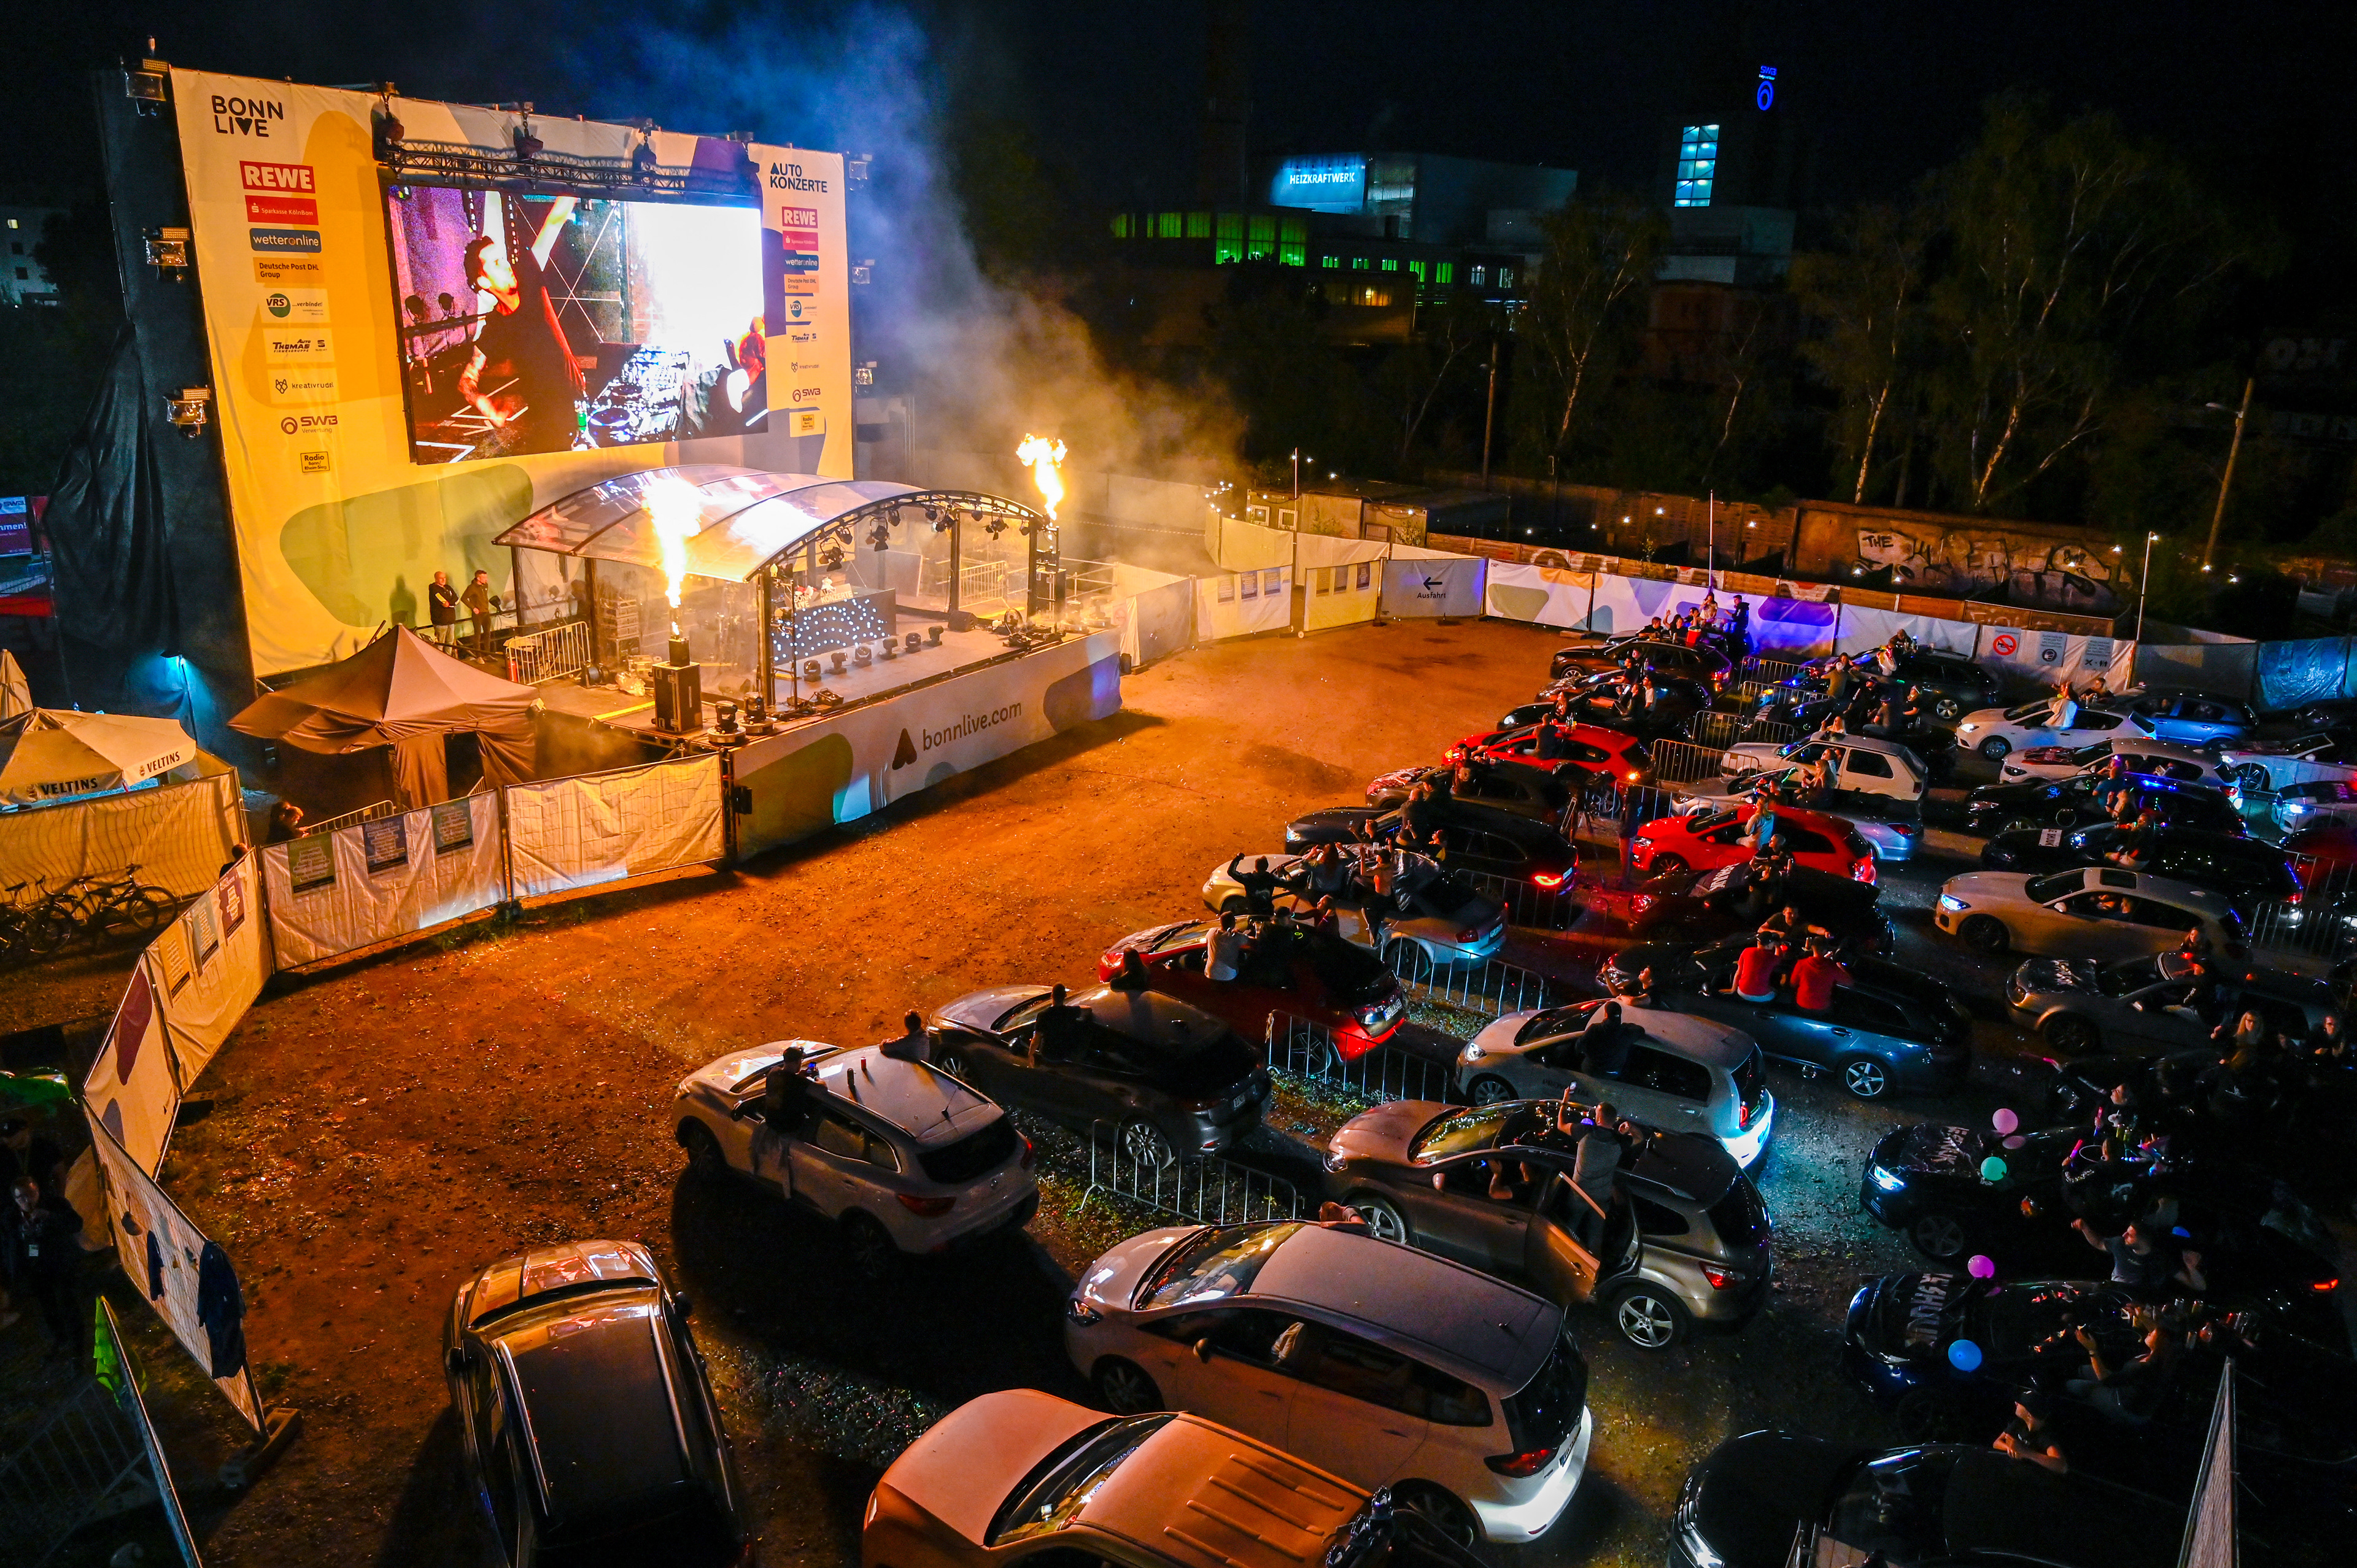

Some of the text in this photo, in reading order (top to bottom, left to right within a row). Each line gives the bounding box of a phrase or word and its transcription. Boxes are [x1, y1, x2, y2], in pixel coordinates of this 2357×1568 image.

[1760, 65, 1777, 75] SWB
[212, 95, 284, 120] BONN
[214, 115, 269, 137] LIVE
[244, 165, 312, 189] REWE
[770, 163, 802, 177] AUTO
[770, 176, 828, 193] KONZERTE
[1290, 172, 1355, 184] HEIZKRAFTWERK
[784, 209, 816, 225] REWE
[253, 234, 319, 247] wetteronline
[259, 262, 290, 271] Deutsche
[300, 415, 338, 427] SWB
[1862, 535, 1895, 549] THE
[820, 590, 854, 604] KONZERTE
[923, 702, 1022, 752] bonnlive.com
[146, 751, 180, 773] VELTINS
[41, 778, 98, 796] VELTINS
